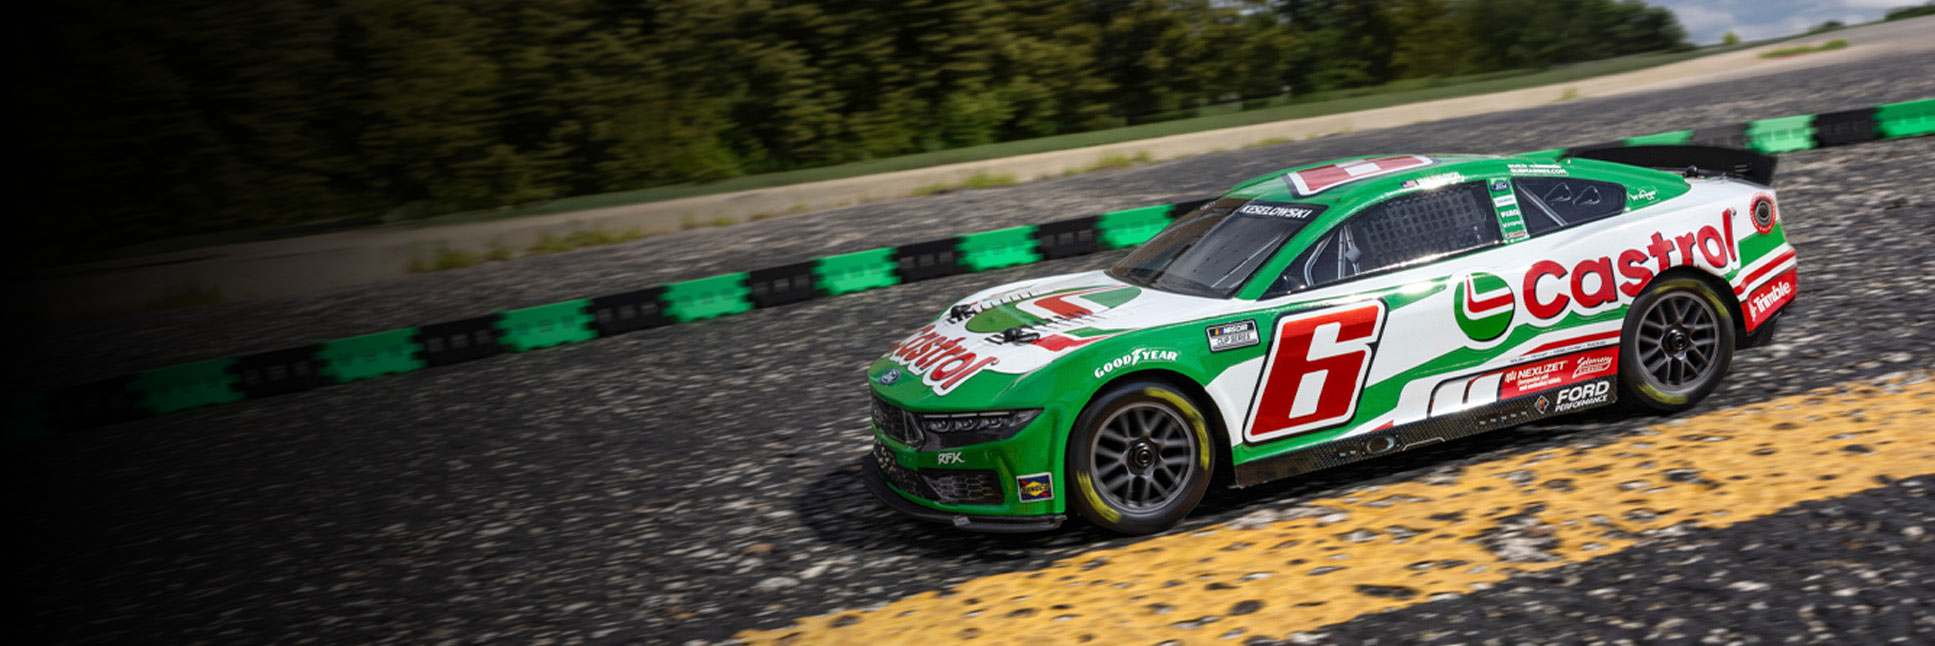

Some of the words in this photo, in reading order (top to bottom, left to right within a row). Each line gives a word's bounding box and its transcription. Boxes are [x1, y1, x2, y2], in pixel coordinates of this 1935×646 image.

[1240, 205, 1312, 218] KESELOWSKI
[1523, 208, 1735, 319] Castrol
[1753, 281, 1791, 313] Trimble
[1224, 323, 1248, 335] NASCAR
[1094, 348, 1178, 378] GOODYEAR
[1249, 304, 1380, 437] 6
[1555, 394, 1608, 412] PERFORMANCE
[1556, 381, 1610, 405] FORD
